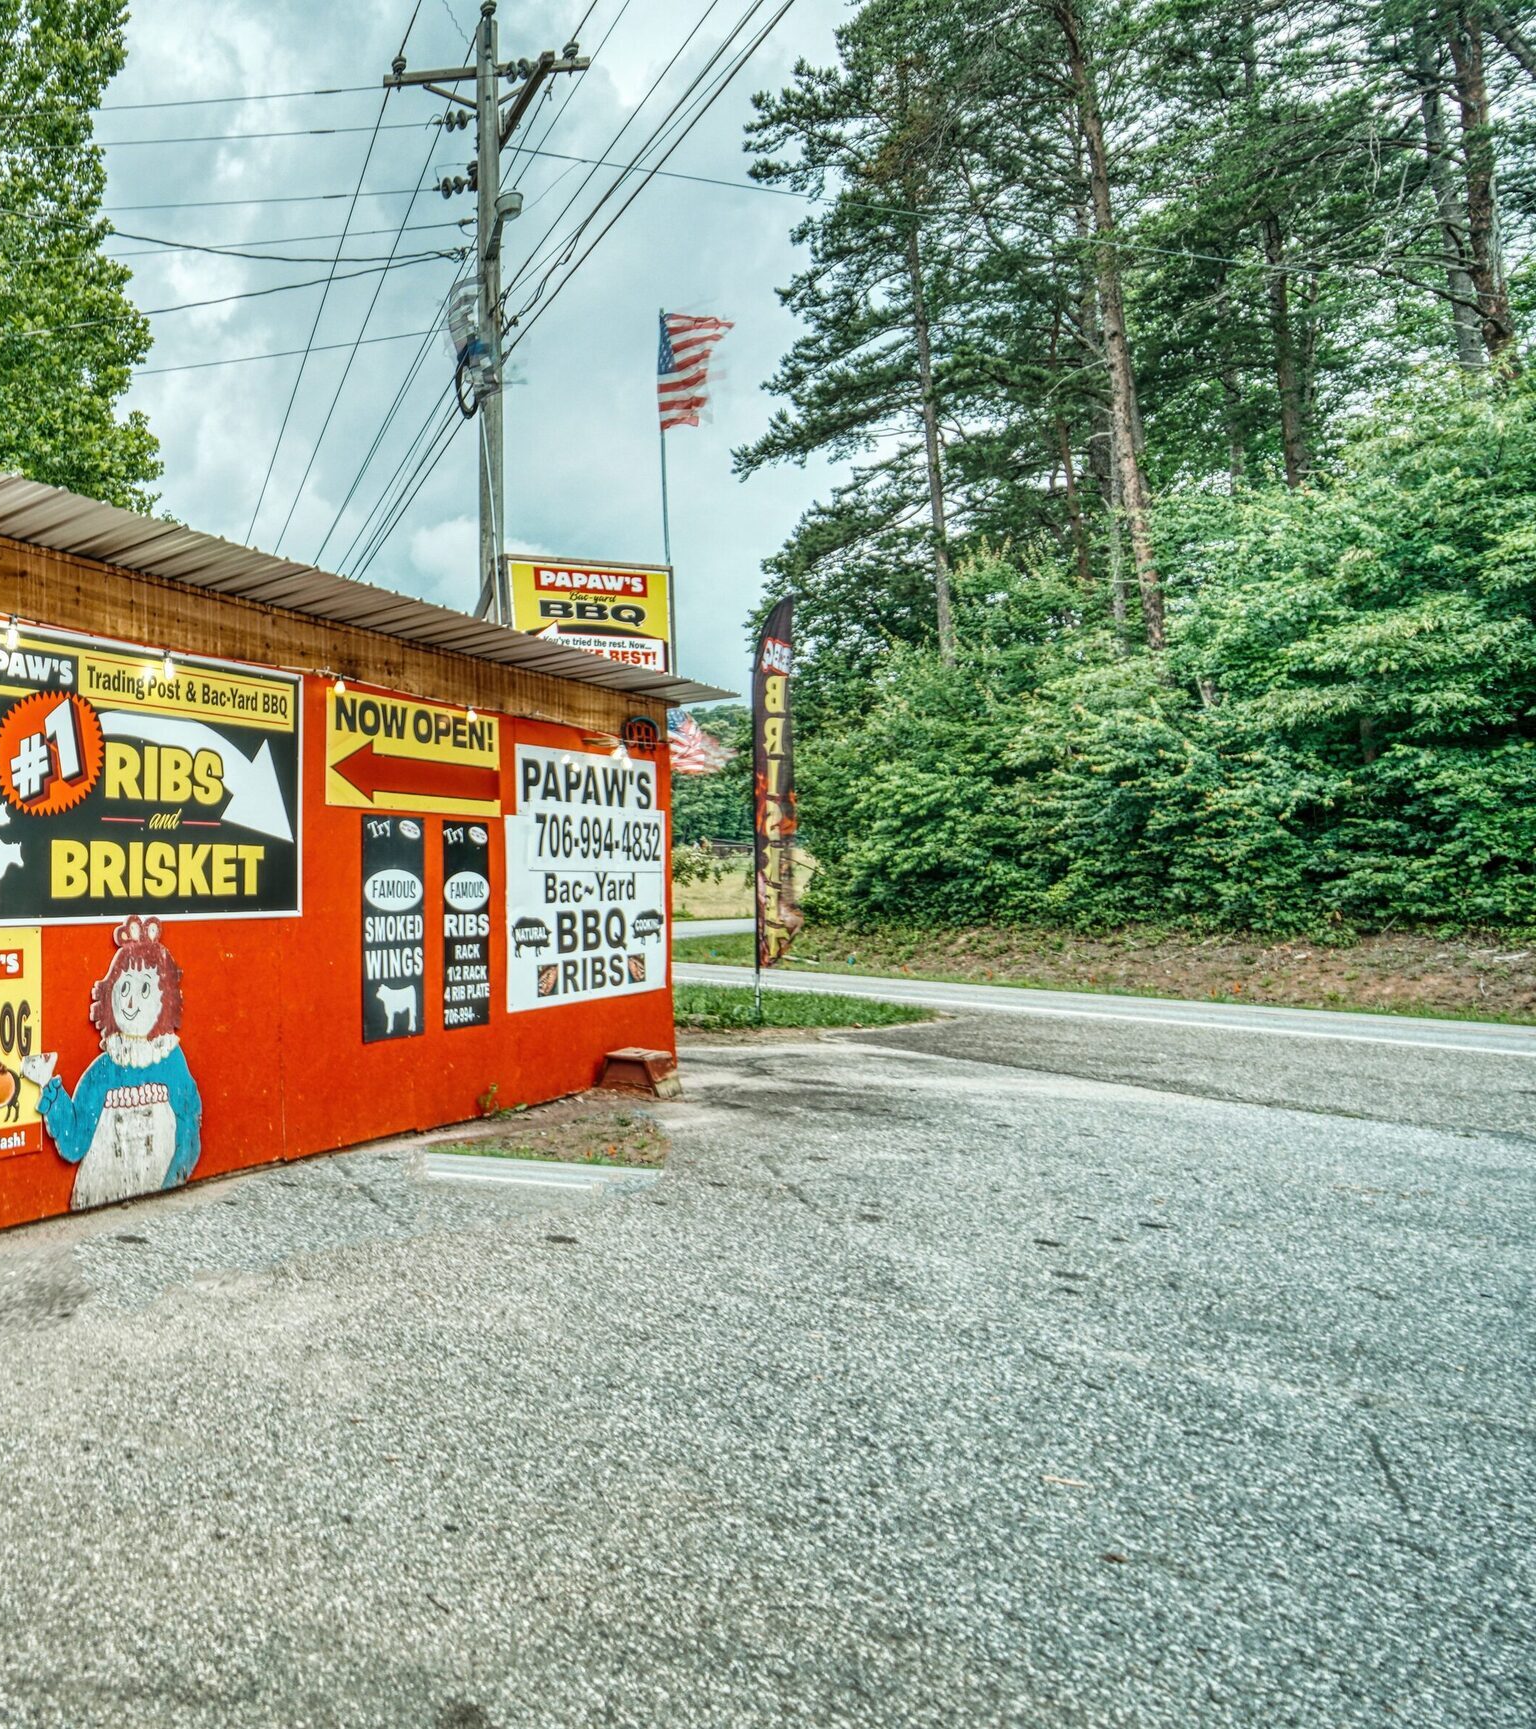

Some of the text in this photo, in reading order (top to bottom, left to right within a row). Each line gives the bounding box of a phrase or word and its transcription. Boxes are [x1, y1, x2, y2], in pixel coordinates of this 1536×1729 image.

[539, 570, 644, 593] PAPAW'S
[569, 590, 616, 604] Bac-yard
[539, 599, 646, 627] BBQ
[572, 637, 592, 646] tried
[593, 638, 607, 648] the
[609, 650, 657, 665] BEST!
[87, 665, 288, 719] Trading Post & Bac-Yard BBQ
[335, 695, 494, 752] NOW OPEN!
[10, 698, 81, 801] #1
[104, 742, 224, 805] RIBS
[522, 758, 652, 810] PAPAW'S
[148, 808, 182, 830] and
[367, 820, 390, 838] Try
[443, 827, 464, 844] Try
[535, 813, 661, 861] 706-994-4832
[51, 839, 265, 898] BRISKET
[372, 880, 416, 898] FAMOUS
[450, 881, 484, 899] FAMOUS
[365, 915, 423, 943] SMOKED
[444, 914, 490, 937] RIBS
[514, 926, 548, 942] NATURAL
[556, 907, 627, 954] BBQ
[365, 947, 423, 980] WINGS
[454, 944, 480, 960] RACK
[462, 965, 487, 980] RACK
[562, 953, 625, 994] RIBS
[444, 983, 490, 1002] 4 RIB PLATE
